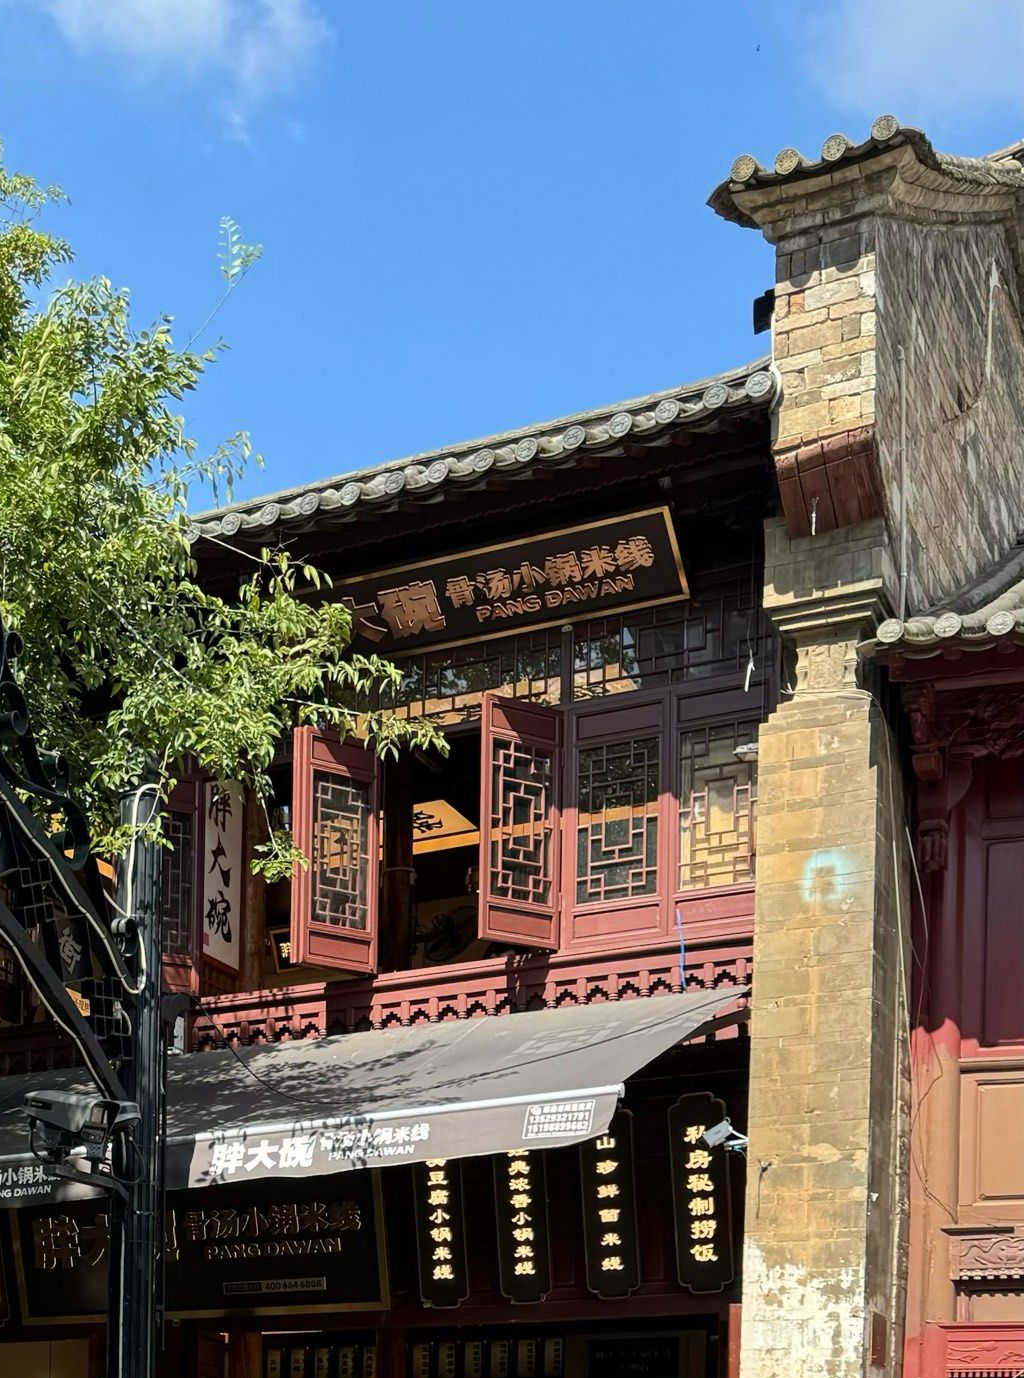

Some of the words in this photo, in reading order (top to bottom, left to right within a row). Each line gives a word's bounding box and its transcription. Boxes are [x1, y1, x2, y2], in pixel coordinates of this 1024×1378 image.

[445, 536, 654, 608] 骨汤小锅米线
[476, 594, 541, 623] PANG
[544, 574, 634, 609] DAWAN
[206, 783, 234, 944] 胖大碗
[209, 1132, 314, 1175] 胖大碗
[318, 1121, 430, 1152] 骨汤小锅米线
[14, 1184, 52, 1197] DAWAN
[184, 1202, 363, 1241] 骨汤小锅米线
[507, 1150, 536, 1275] 典浓香小锅米线
[206, 1242, 262, 1260] PANG
[264, 1238, 343, 1256] DAWAN
